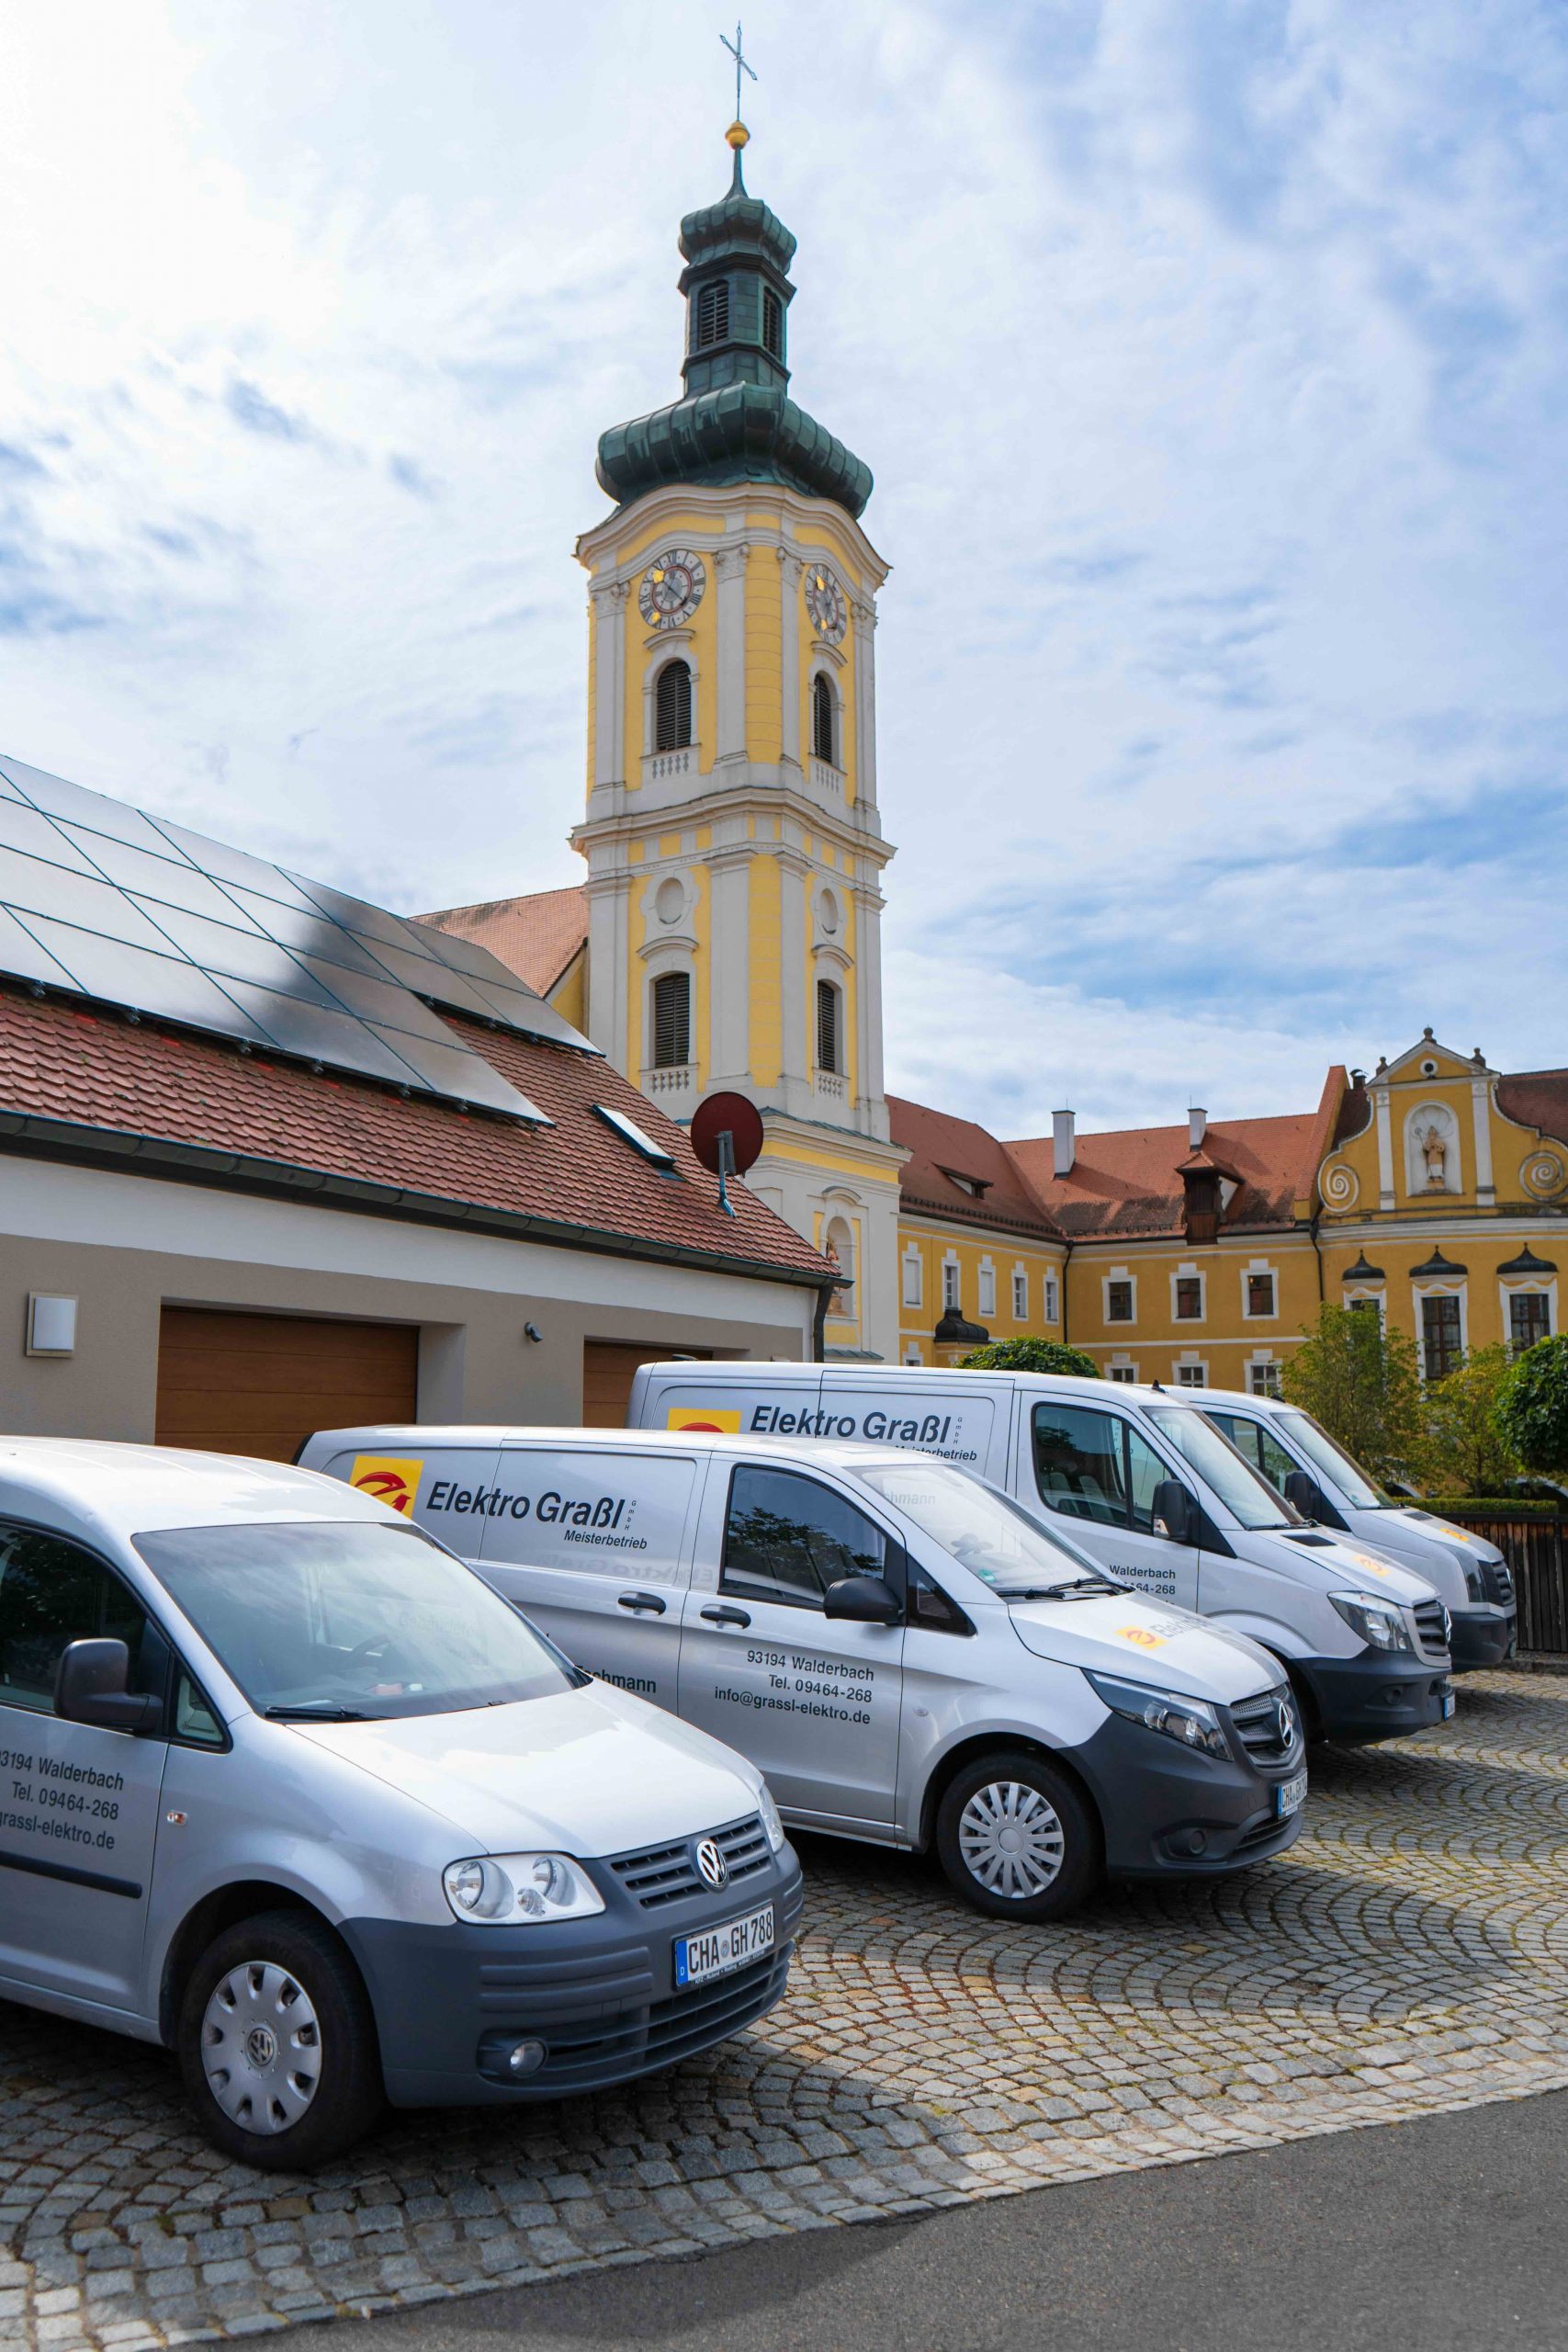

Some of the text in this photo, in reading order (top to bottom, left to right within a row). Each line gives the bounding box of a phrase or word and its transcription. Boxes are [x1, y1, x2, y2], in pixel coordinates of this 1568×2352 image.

[750, 1406, 952, 1443] Elektro Graßl
[895, 1445, 977, 1461] terbetrieb
[426, 1481, 626, 1530] Elektro Graßl
[624, 1499, 637, 1531] GmbH
[564, 1530, 648, 1550] Meisterbetrieb
[1109, 1565, 1176, 1579] Walderbach
[1124, 1581, 1176, 1595] 64-268
[575, 1666, 657, 1693] hmann
[747, 1650, 874, 1682] 93194 Walderbach
[768, 1674, 873, 1703] Tel. 09464-268
[715, 1686, 871, 1724] info@grassl-elektro.de
[0, 1750, 124, 1791] 3194 Walderbach
[12, 1781, 119, 1821] Tel. 09464-268
[689, 1935, 720, 1973] CHA
[730, 1923, 749, 1957] GH
[751, 1912, 773, 1949] 788
